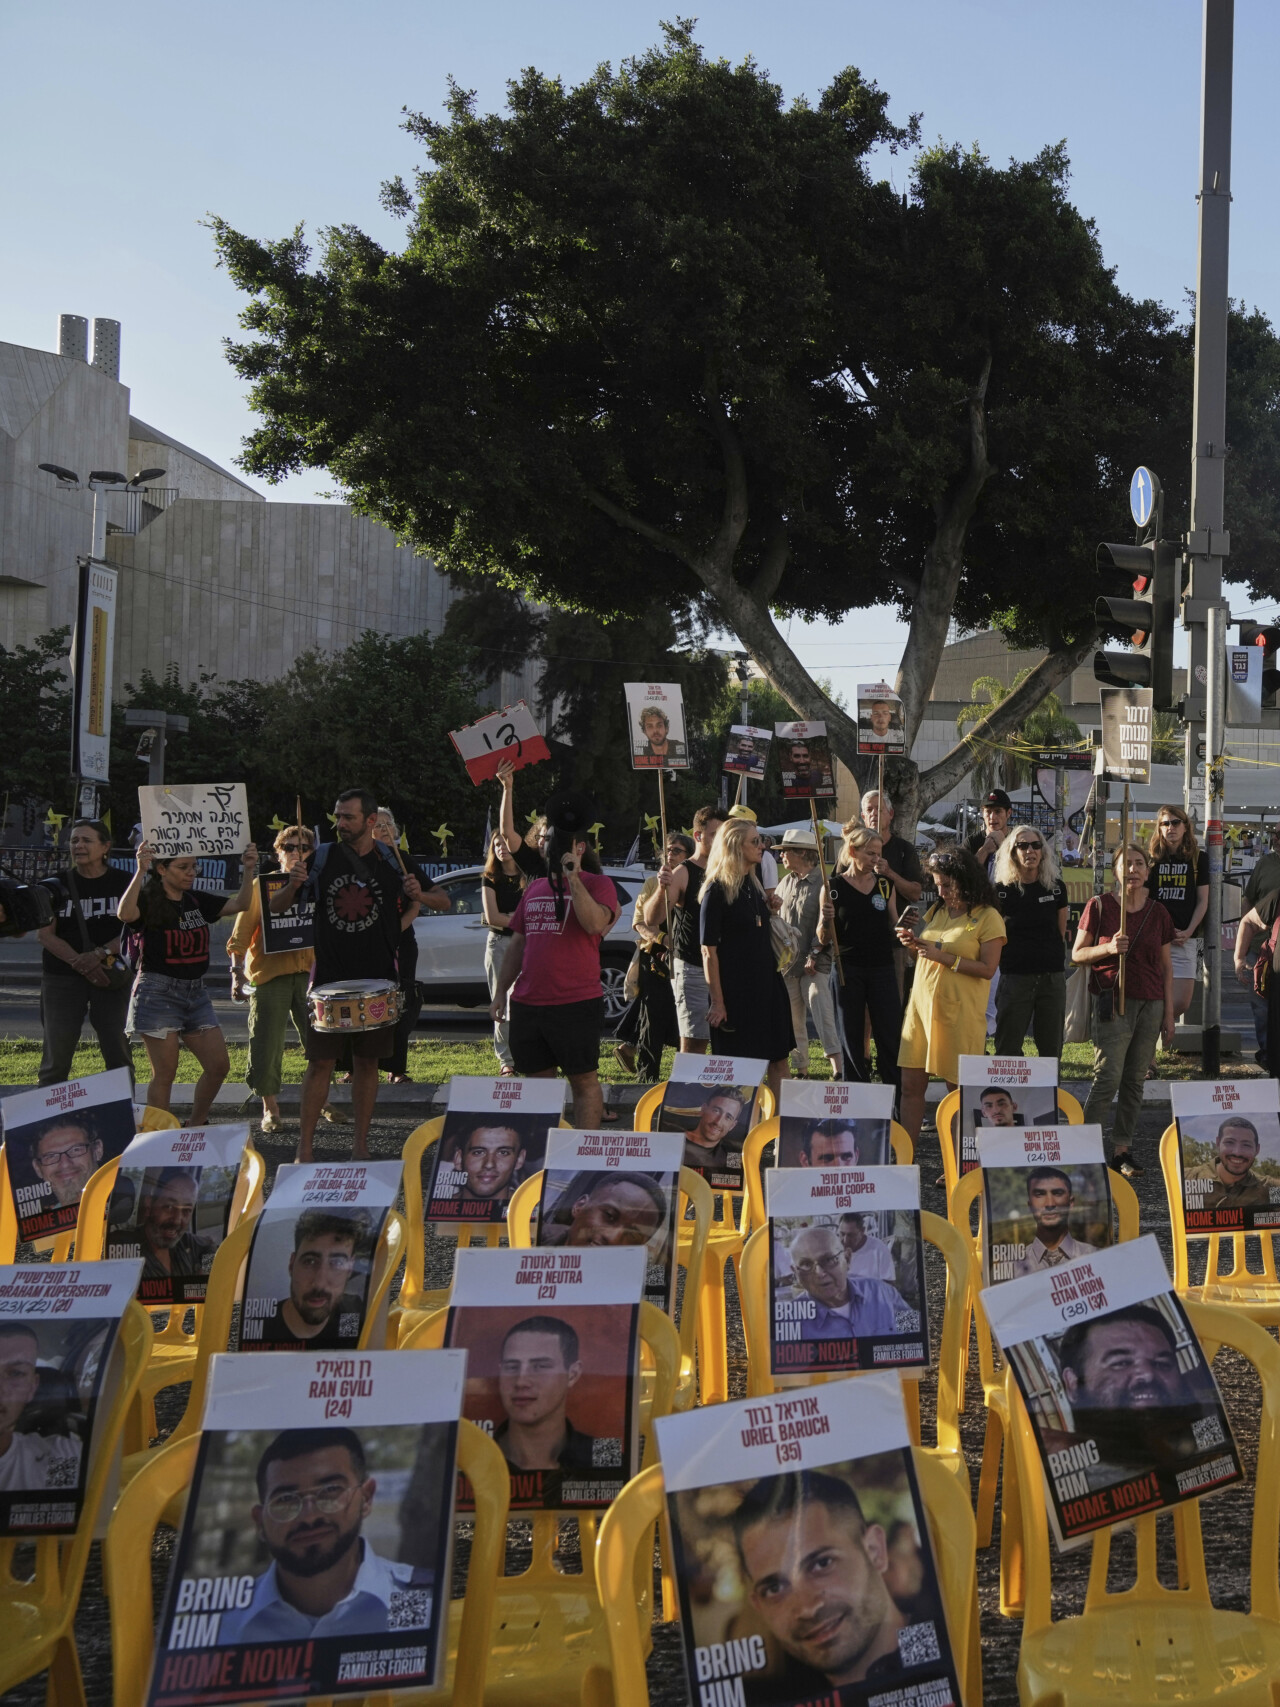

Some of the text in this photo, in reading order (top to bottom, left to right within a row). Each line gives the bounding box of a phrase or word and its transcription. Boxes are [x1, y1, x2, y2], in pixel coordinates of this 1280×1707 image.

[1234, 662, 1246, 670] נגד
[1124, 705, 1149, 723] דרמר
[1119, 724, 1148, 743] מנותק
[1120, 743, 1147, 760] מהעם
[1158, 863, 1188, 875] למה הם
[327, 874, 350, 895] HOT
[1158, 874, 1187, 888] עדיין
[1157, 887, 1186, 900] בעזה?
[326, 896, 339, 924] RED
[60, 1099, 76, 1111] (54)
[499, 1100, 512, 1109] (19)
[829, 1104, 843, 1115] (48)
[170, 1142, 207, 1153] EITAN LEVI
[576, 1145, 652, 1158] JOSHUA LOITU MOLLEL
[1022, 1141, 1061, 1153] BIPIN JOSHI
[177, 1152, 194, 1163] (53)
[605, 1156, 621, 1168] (21)
[303, 1179, 368, 1191] GUY GILBOA-DALAL
[820, 1171, 865, 1185] עמירם קופר
[810, 1183, 876, 1198] AMIRAM COOPER
[834, 1195, 852, 1209] (85)
[520, 1254, 582, 1270] עומר נאוטרה
[12, 1270, 81, 1286] בר קופרשטיין
[515, 1270, 583, 1285] OMER NEUTRA
[1049, 1263, 1095, 1292] איתן הורן
[537, 1284, 558, 1300] (21)
[1050, 1276, 1105, 1307] EITAN HORN
[775, 1300, 817, 1321] BRING
[775, 1321, 801, 1341] HIM
[315, 1358, 372, 1379] רן גואילי
[308, 1379, 373, 1399] RAN GVILI
[324, 1398, 352, 1420] (24)
[743, 1396, 821, 1429] אוריאל ברוך
[740, 1415, 831, 1449] URIEL BARUCH
[775, 1441, 803, 1465] (35)
[1047, 1438, 1100, 1480] BRING
[1054, 1470, 1090, 1503] HIM
[177, 1575, 255, 1614] BRING
[167, 1612, 222, 1651] HIM
[159, 1640, 317, 1693] HOME NOW!
[694, 1634, 767, 1682] BRING
